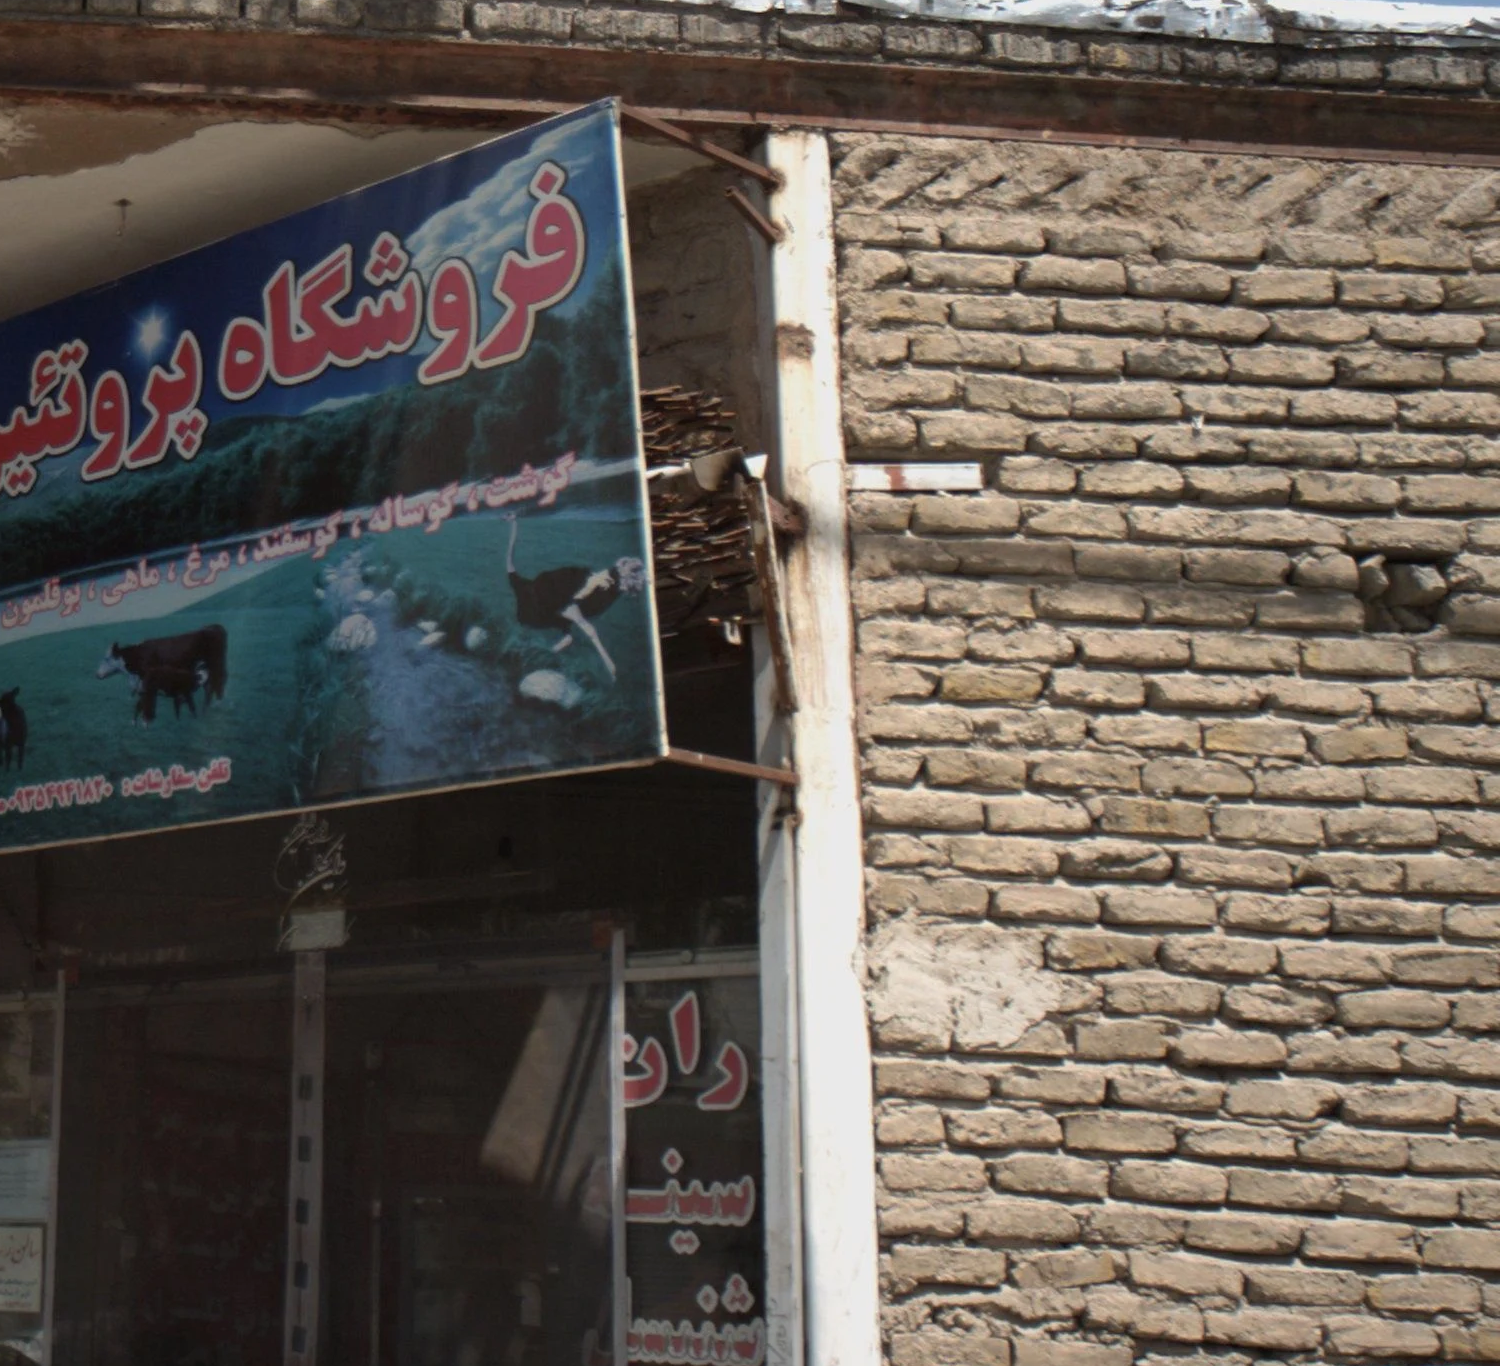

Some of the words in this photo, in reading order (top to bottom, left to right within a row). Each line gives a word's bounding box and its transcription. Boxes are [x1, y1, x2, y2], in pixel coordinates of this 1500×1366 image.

[218, 160, 586, 401] فروشگاه
[484, 449, 576, 508] گوشت
[368, 480, 460, 532] گوساله
[252, 510, 344, 560] گوسفند
[102, 556, 161, 606] ماهی
[182, 543, 231, 588] مرغ
[1, 574, 82, 629] بوقلمون
[196, 756, 232, 793] تلفن
[610, 989, 749, 1111] ران
